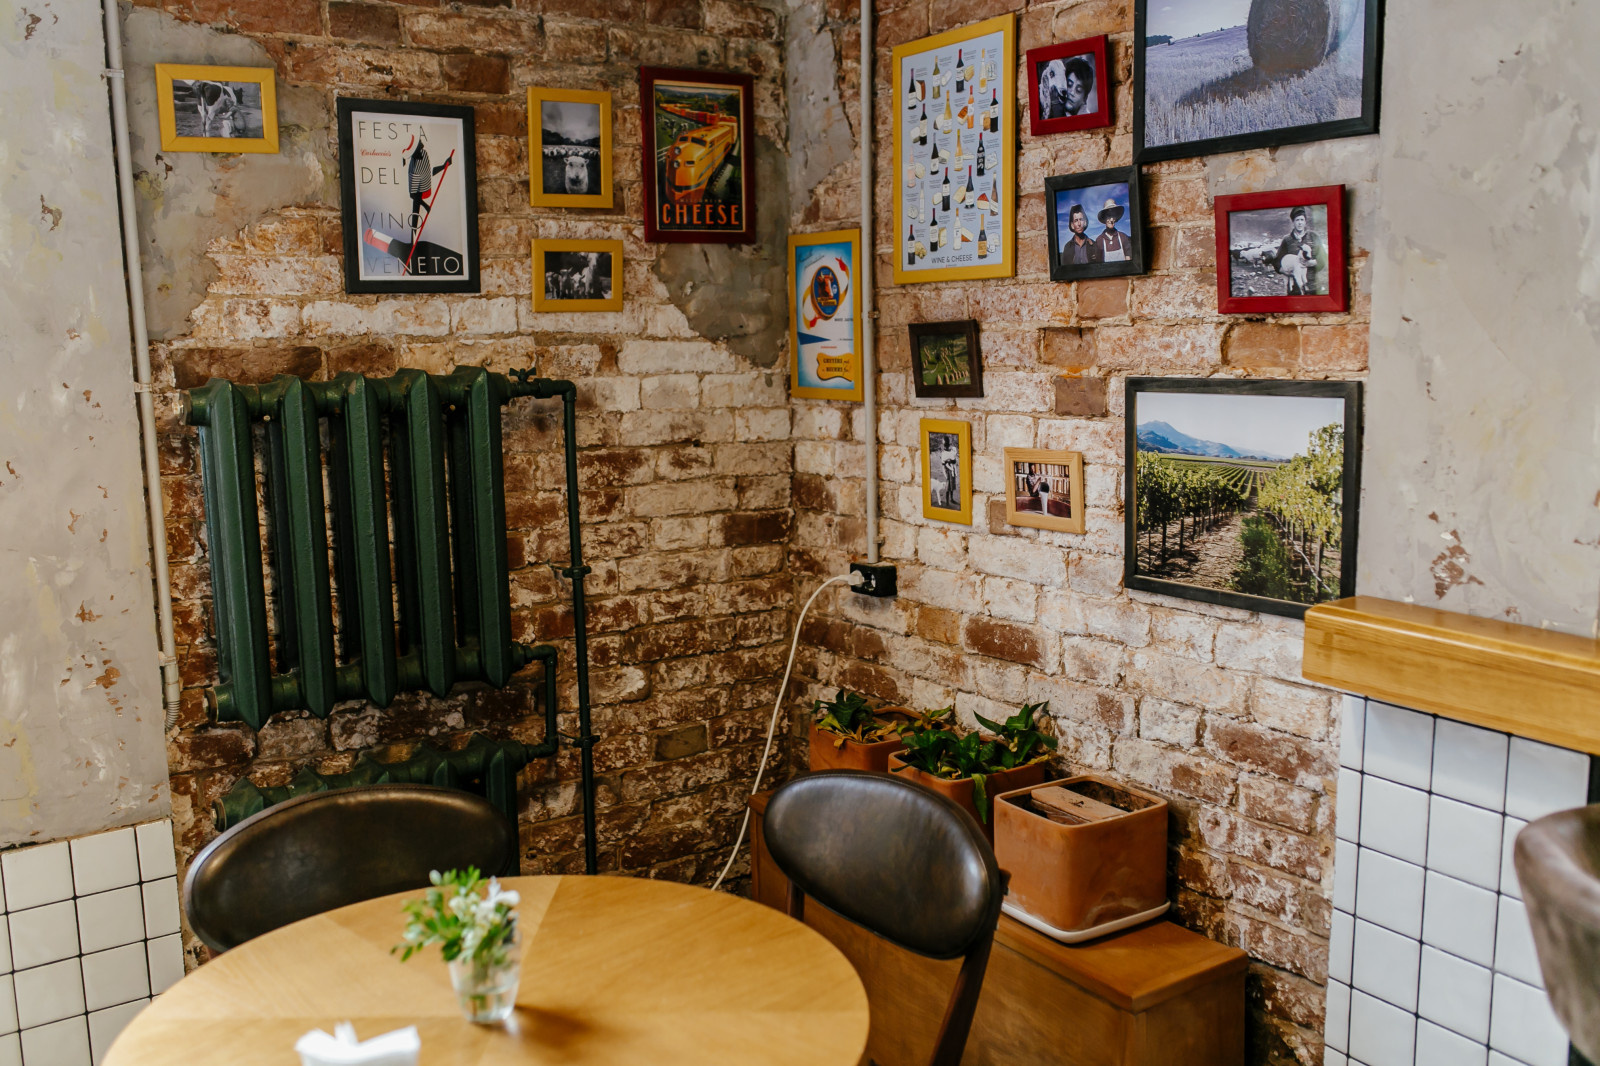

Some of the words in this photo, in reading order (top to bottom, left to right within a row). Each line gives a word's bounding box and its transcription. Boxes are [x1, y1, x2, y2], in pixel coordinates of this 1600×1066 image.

[358, 121, 428, 142] FESTA
[361, 166, 400, 185] DEL
[364, 211, 424, 230] VINO
[662, 203, 739, 224] CHEESE
[366, 256, 460, 274] VENETO
[931, 256, 945, 264] WINE
[946, 255, 950, 263] &
[951, 254, 973, 262] CHEESE
